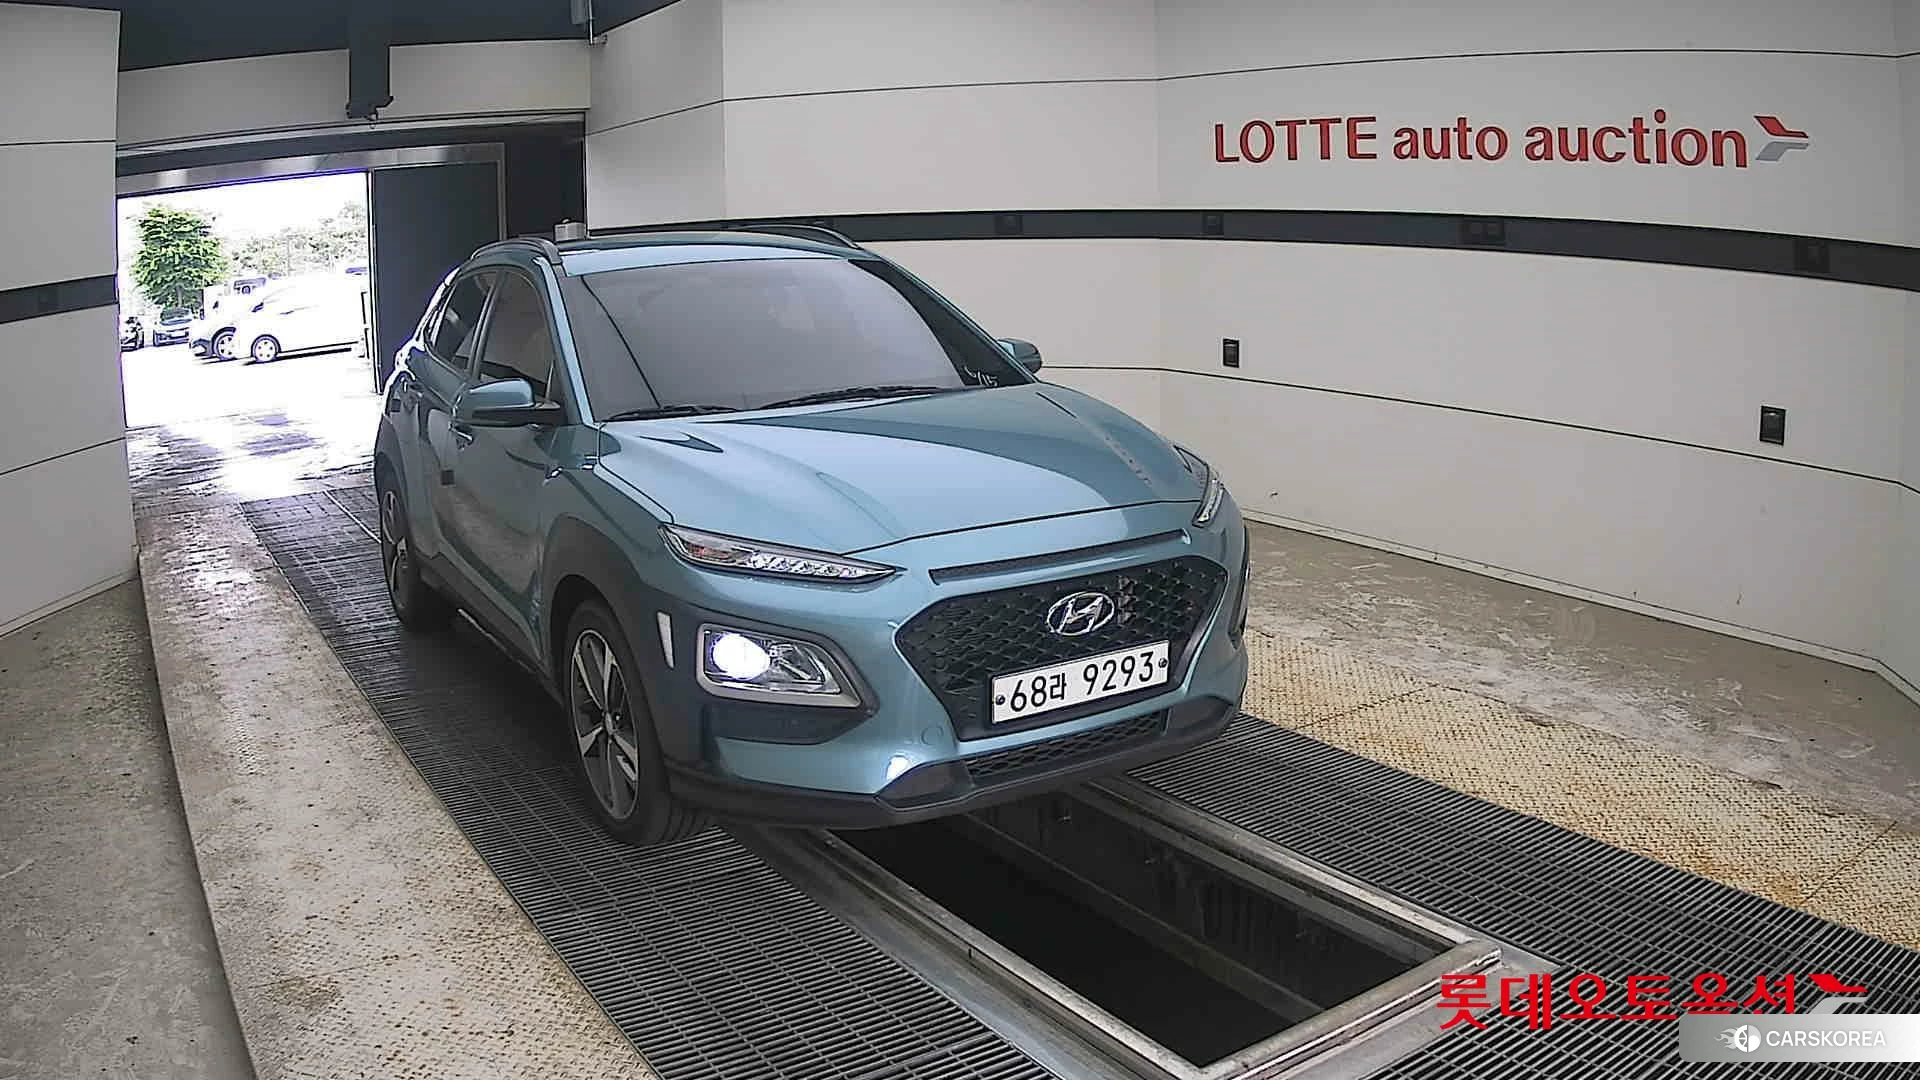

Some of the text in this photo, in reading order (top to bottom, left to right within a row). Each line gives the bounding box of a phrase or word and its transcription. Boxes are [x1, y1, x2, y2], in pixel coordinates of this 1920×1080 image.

[1214, 108, 1748, 168] LOTTE auto auction
[1010, 650, 1154, 713] 68라 9293
